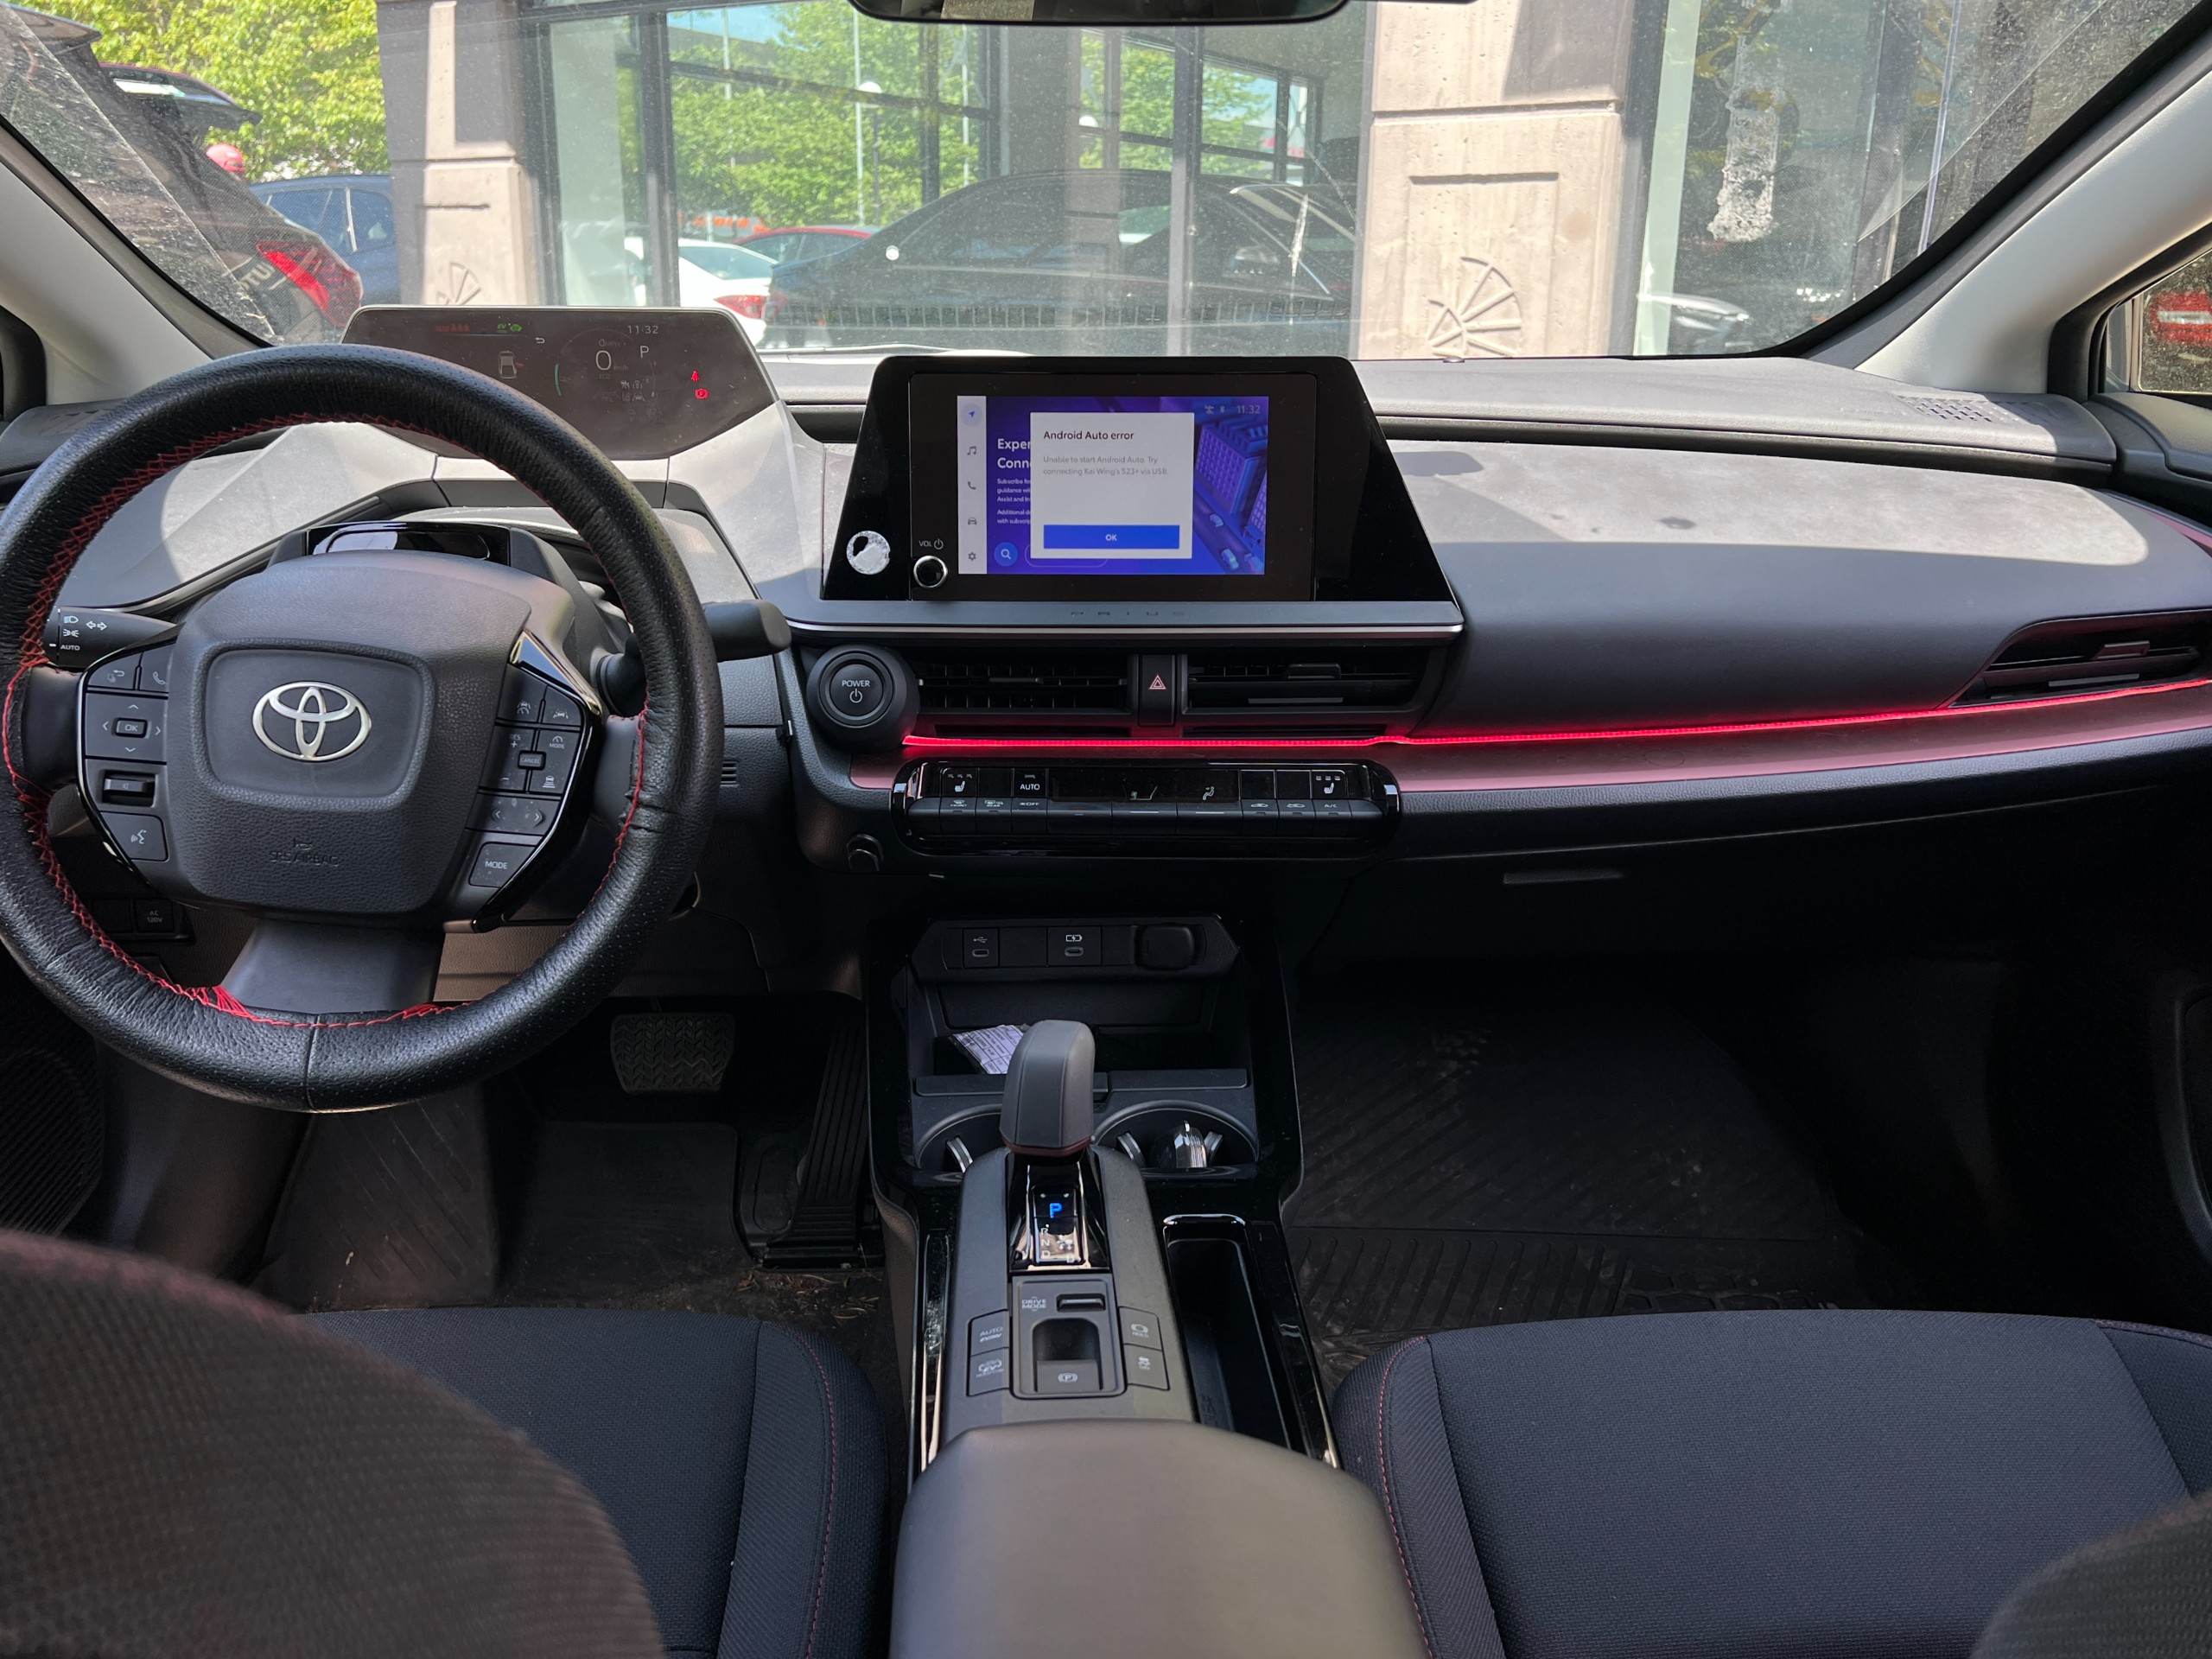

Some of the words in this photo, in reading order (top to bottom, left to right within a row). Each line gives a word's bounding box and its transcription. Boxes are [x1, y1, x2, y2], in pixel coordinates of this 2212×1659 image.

[627, 325, 658, 334] 11:32
[639, 345, 650, 359] P
[595, 350, 612, 371] 0
[1236, 404, 1261, 415] 11:32
[1043, 430, 1083, 440] Android
[1084, 431, 1109, 440] Auto
[997, 457, 1031, 468] Conn
[1147, 456, 1159, 465] Try
[1043, 467, 1083, 476] connecting
[1096, 467, 1121, 476] Wing's
[1105, 533, 1117, 542] OK
[124, 723, 138, 732] OK
[485, 860, 508, 870] MODE
[1049, 1202, 1063, 1218] P
[1040, 1227, 1049, 1236] R
[1041, 1238, 1050, 1247] N
[979, 1326, 1003, 1338] AUTO
